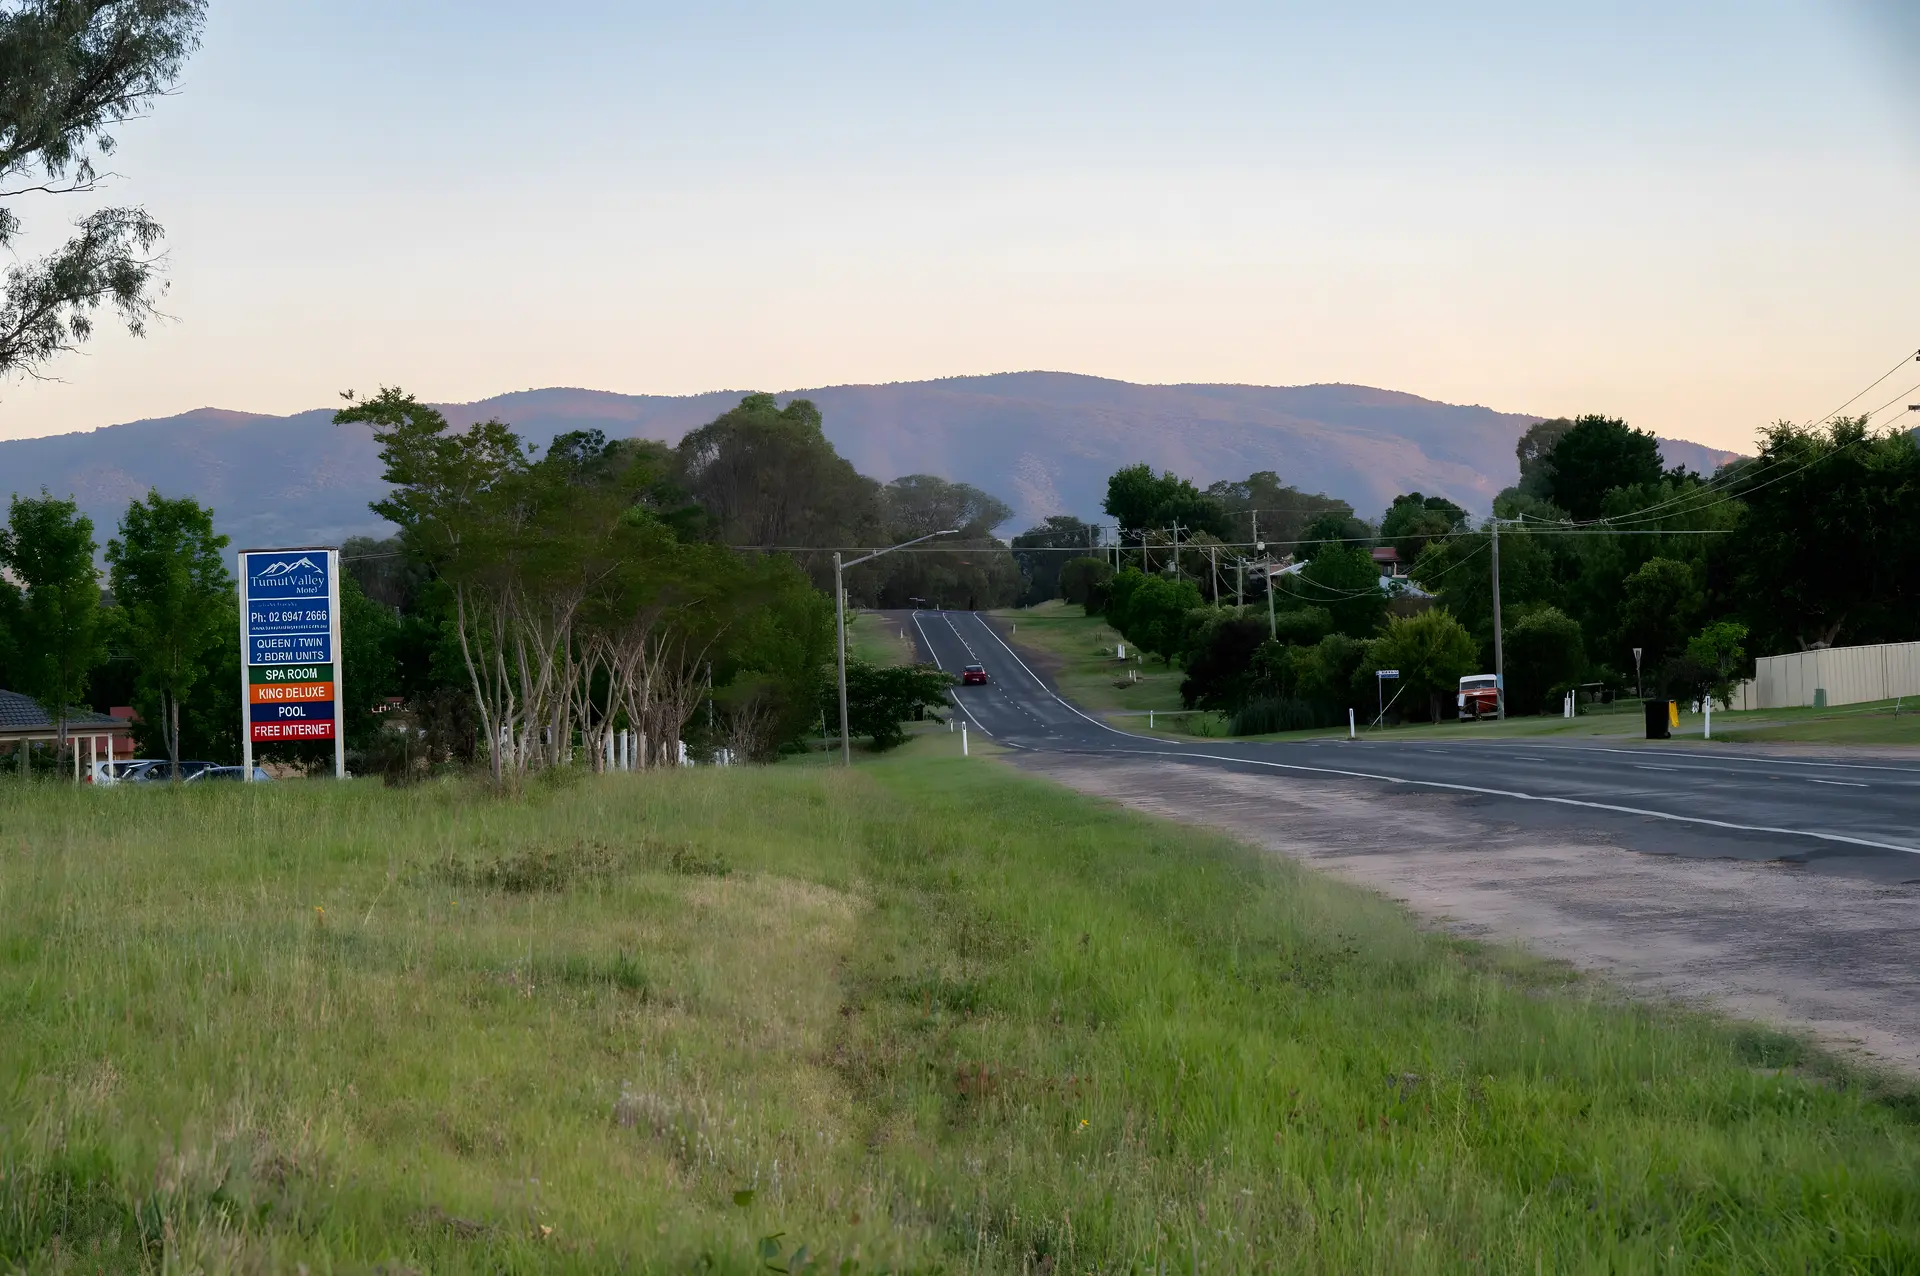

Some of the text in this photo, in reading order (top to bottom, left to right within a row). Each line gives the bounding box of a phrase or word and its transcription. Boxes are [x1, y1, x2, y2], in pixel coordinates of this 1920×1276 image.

[289, 574, 325, 588] Valley
[296, 586, 318, 594] Motel
[251, 610, 327, 623] Ph: 02 6947 2666
[256, 638, 323, 649] QUEEN / TWIN
[256, 650, 324, 662] 2 BDRM UNITS
[265, 668, 317, 680] SPA ROOM
[258, 686, 325, 699] KING DELUXE
[278, 706, 306, 717] POOL
[254, 723, 331, 736] FREE INTERNET
